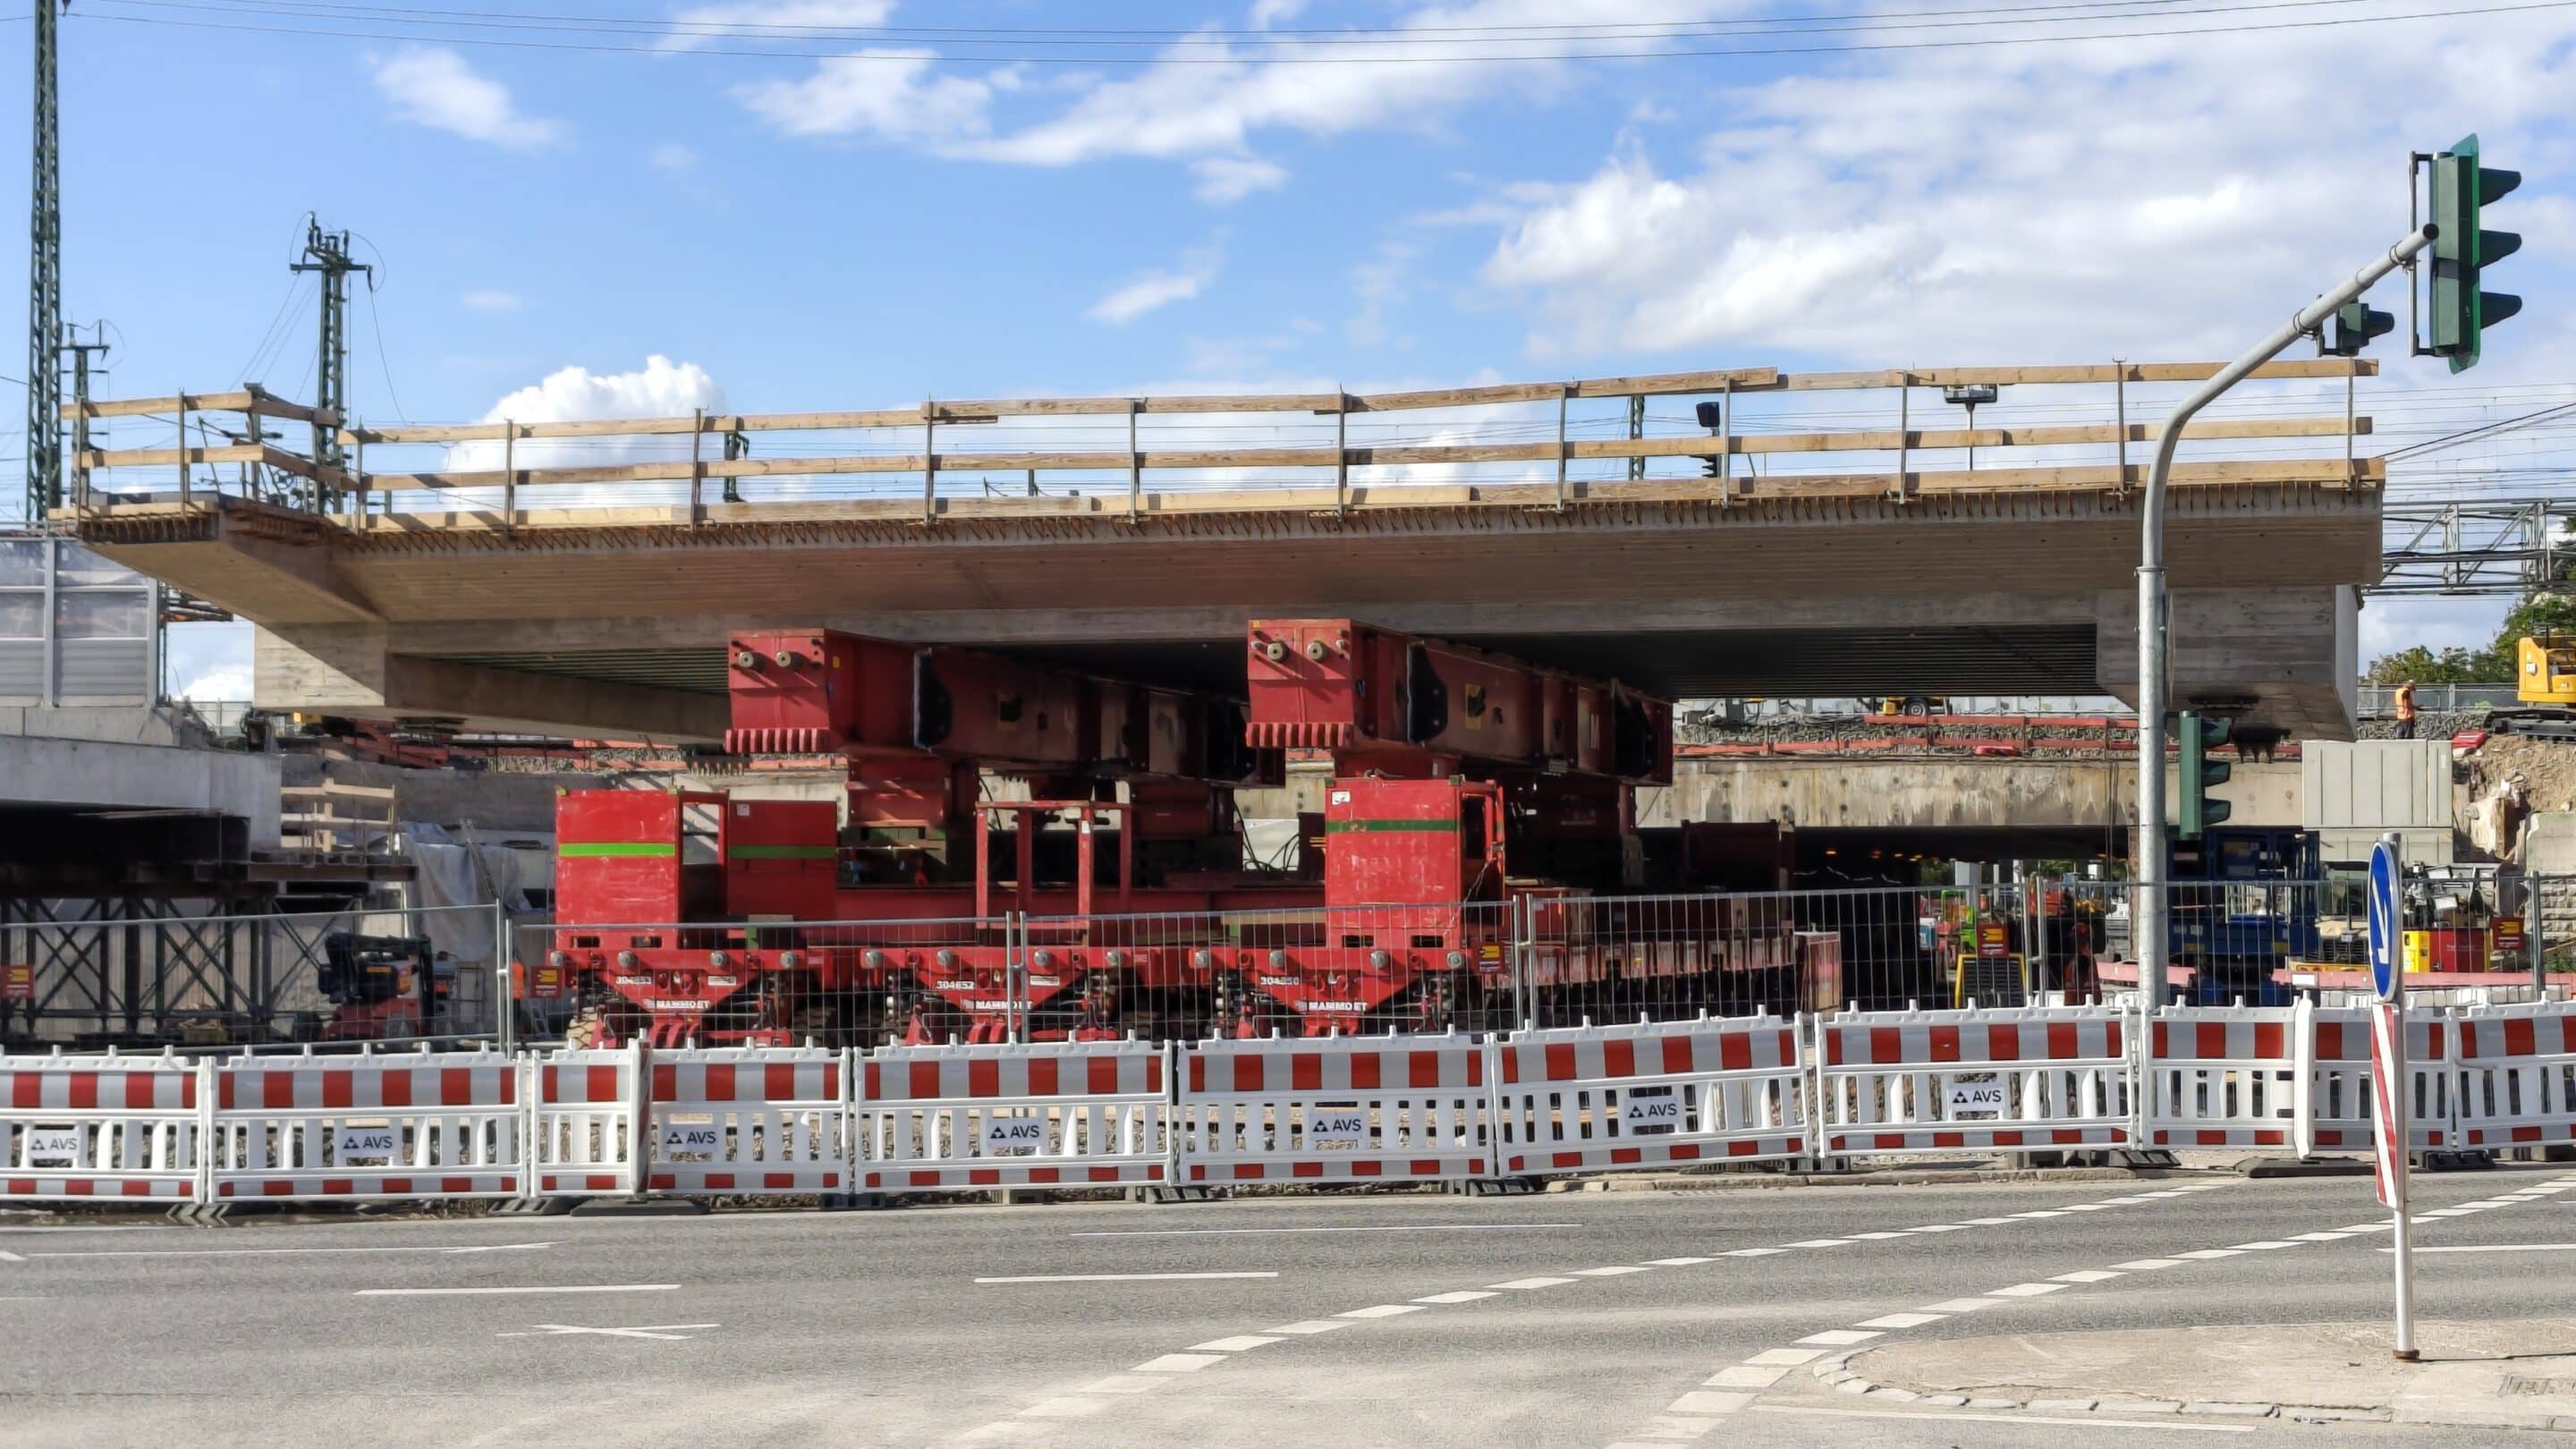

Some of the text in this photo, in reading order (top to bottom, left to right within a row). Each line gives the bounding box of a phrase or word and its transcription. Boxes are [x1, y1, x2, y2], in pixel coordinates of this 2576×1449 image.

[656, 1000, 710, 1009] MAMMOET
[1309, 1001, 1368, 1011] MAMMOET
[1971, 1089, 2002, 1103] AVS
[1648, 1103, 1677, 1116] AVS
[1332, 1119, 1362, 1131] AVS
[686, 1131, 716, 1144] AVS
[1010, 1125, 1040, 1139] AVS
[49, 1139, 78, 1150] AVS
[362, 1136, 393, 1148] AVS
